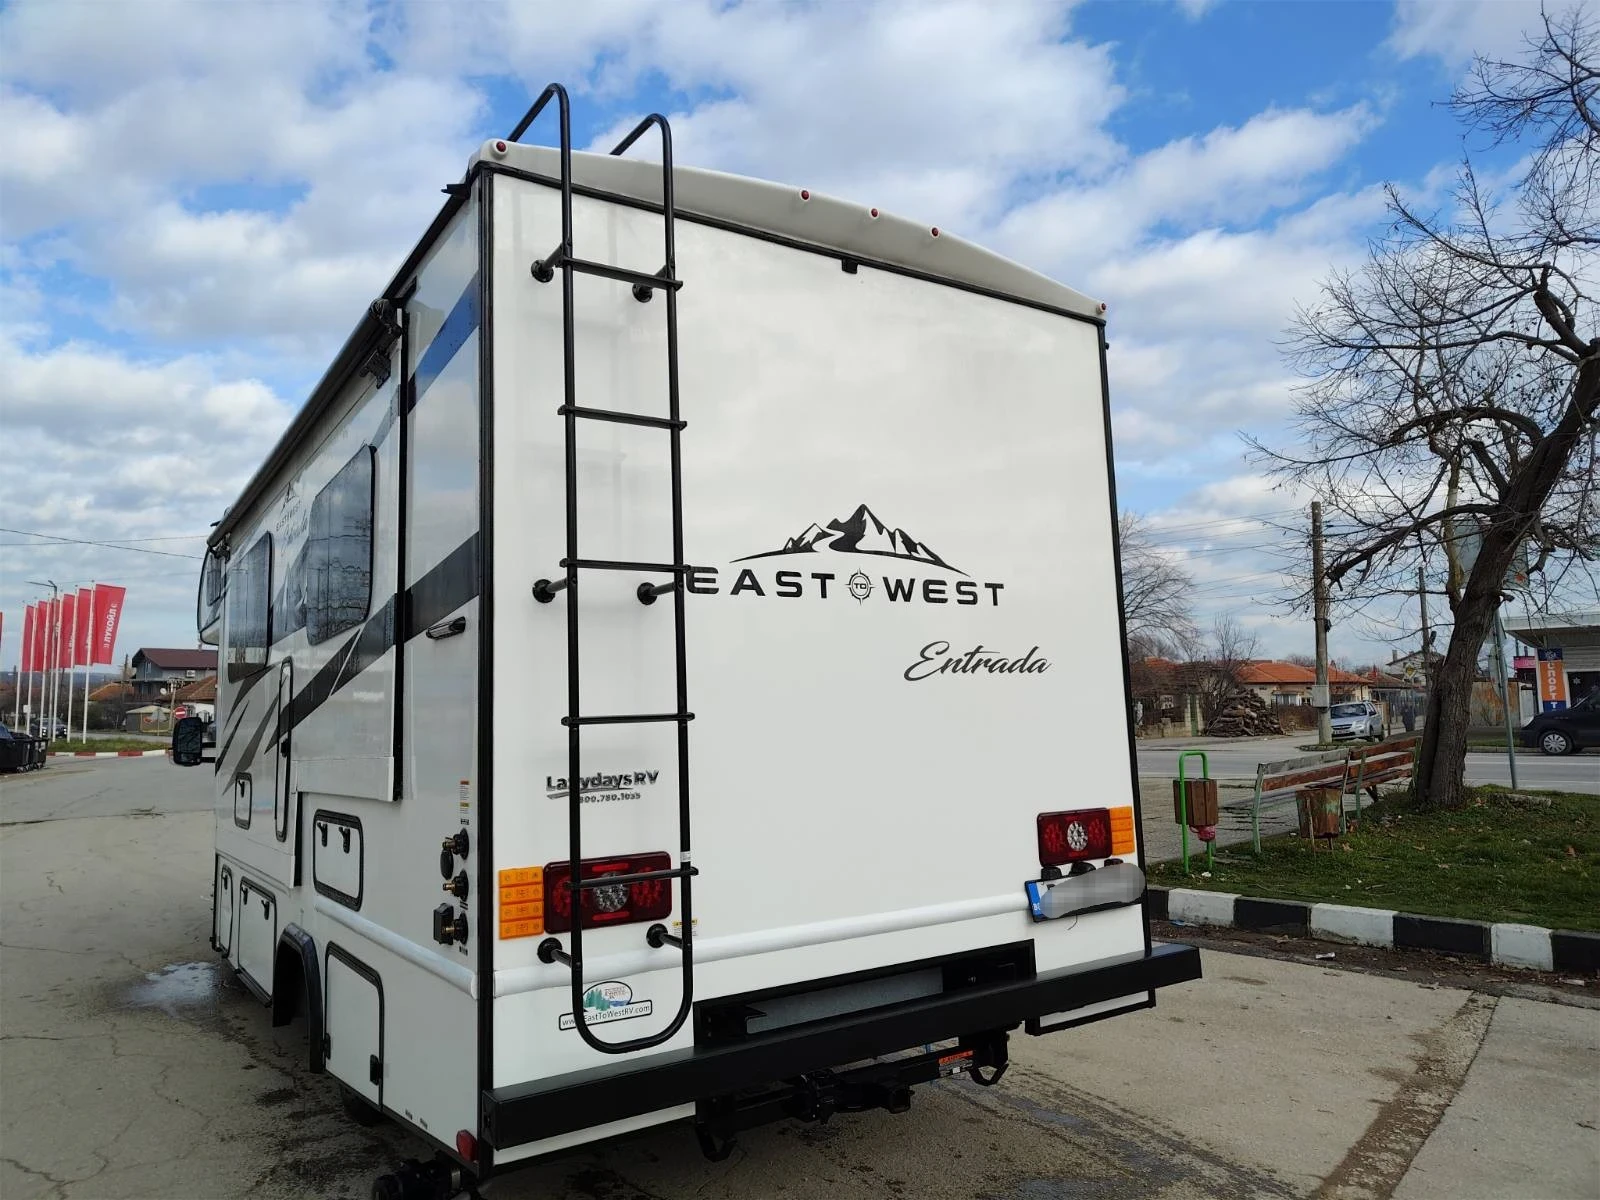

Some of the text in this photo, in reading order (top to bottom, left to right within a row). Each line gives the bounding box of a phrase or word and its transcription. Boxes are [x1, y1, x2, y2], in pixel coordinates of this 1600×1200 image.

[685, 566, 1005, 607] EAST TO WEST
[903, 640, 1052, 682] Entrada
[546, 772, 632, 791] Laydays
[562, 1005, 650, 1026] wwEastToWestRV.com
